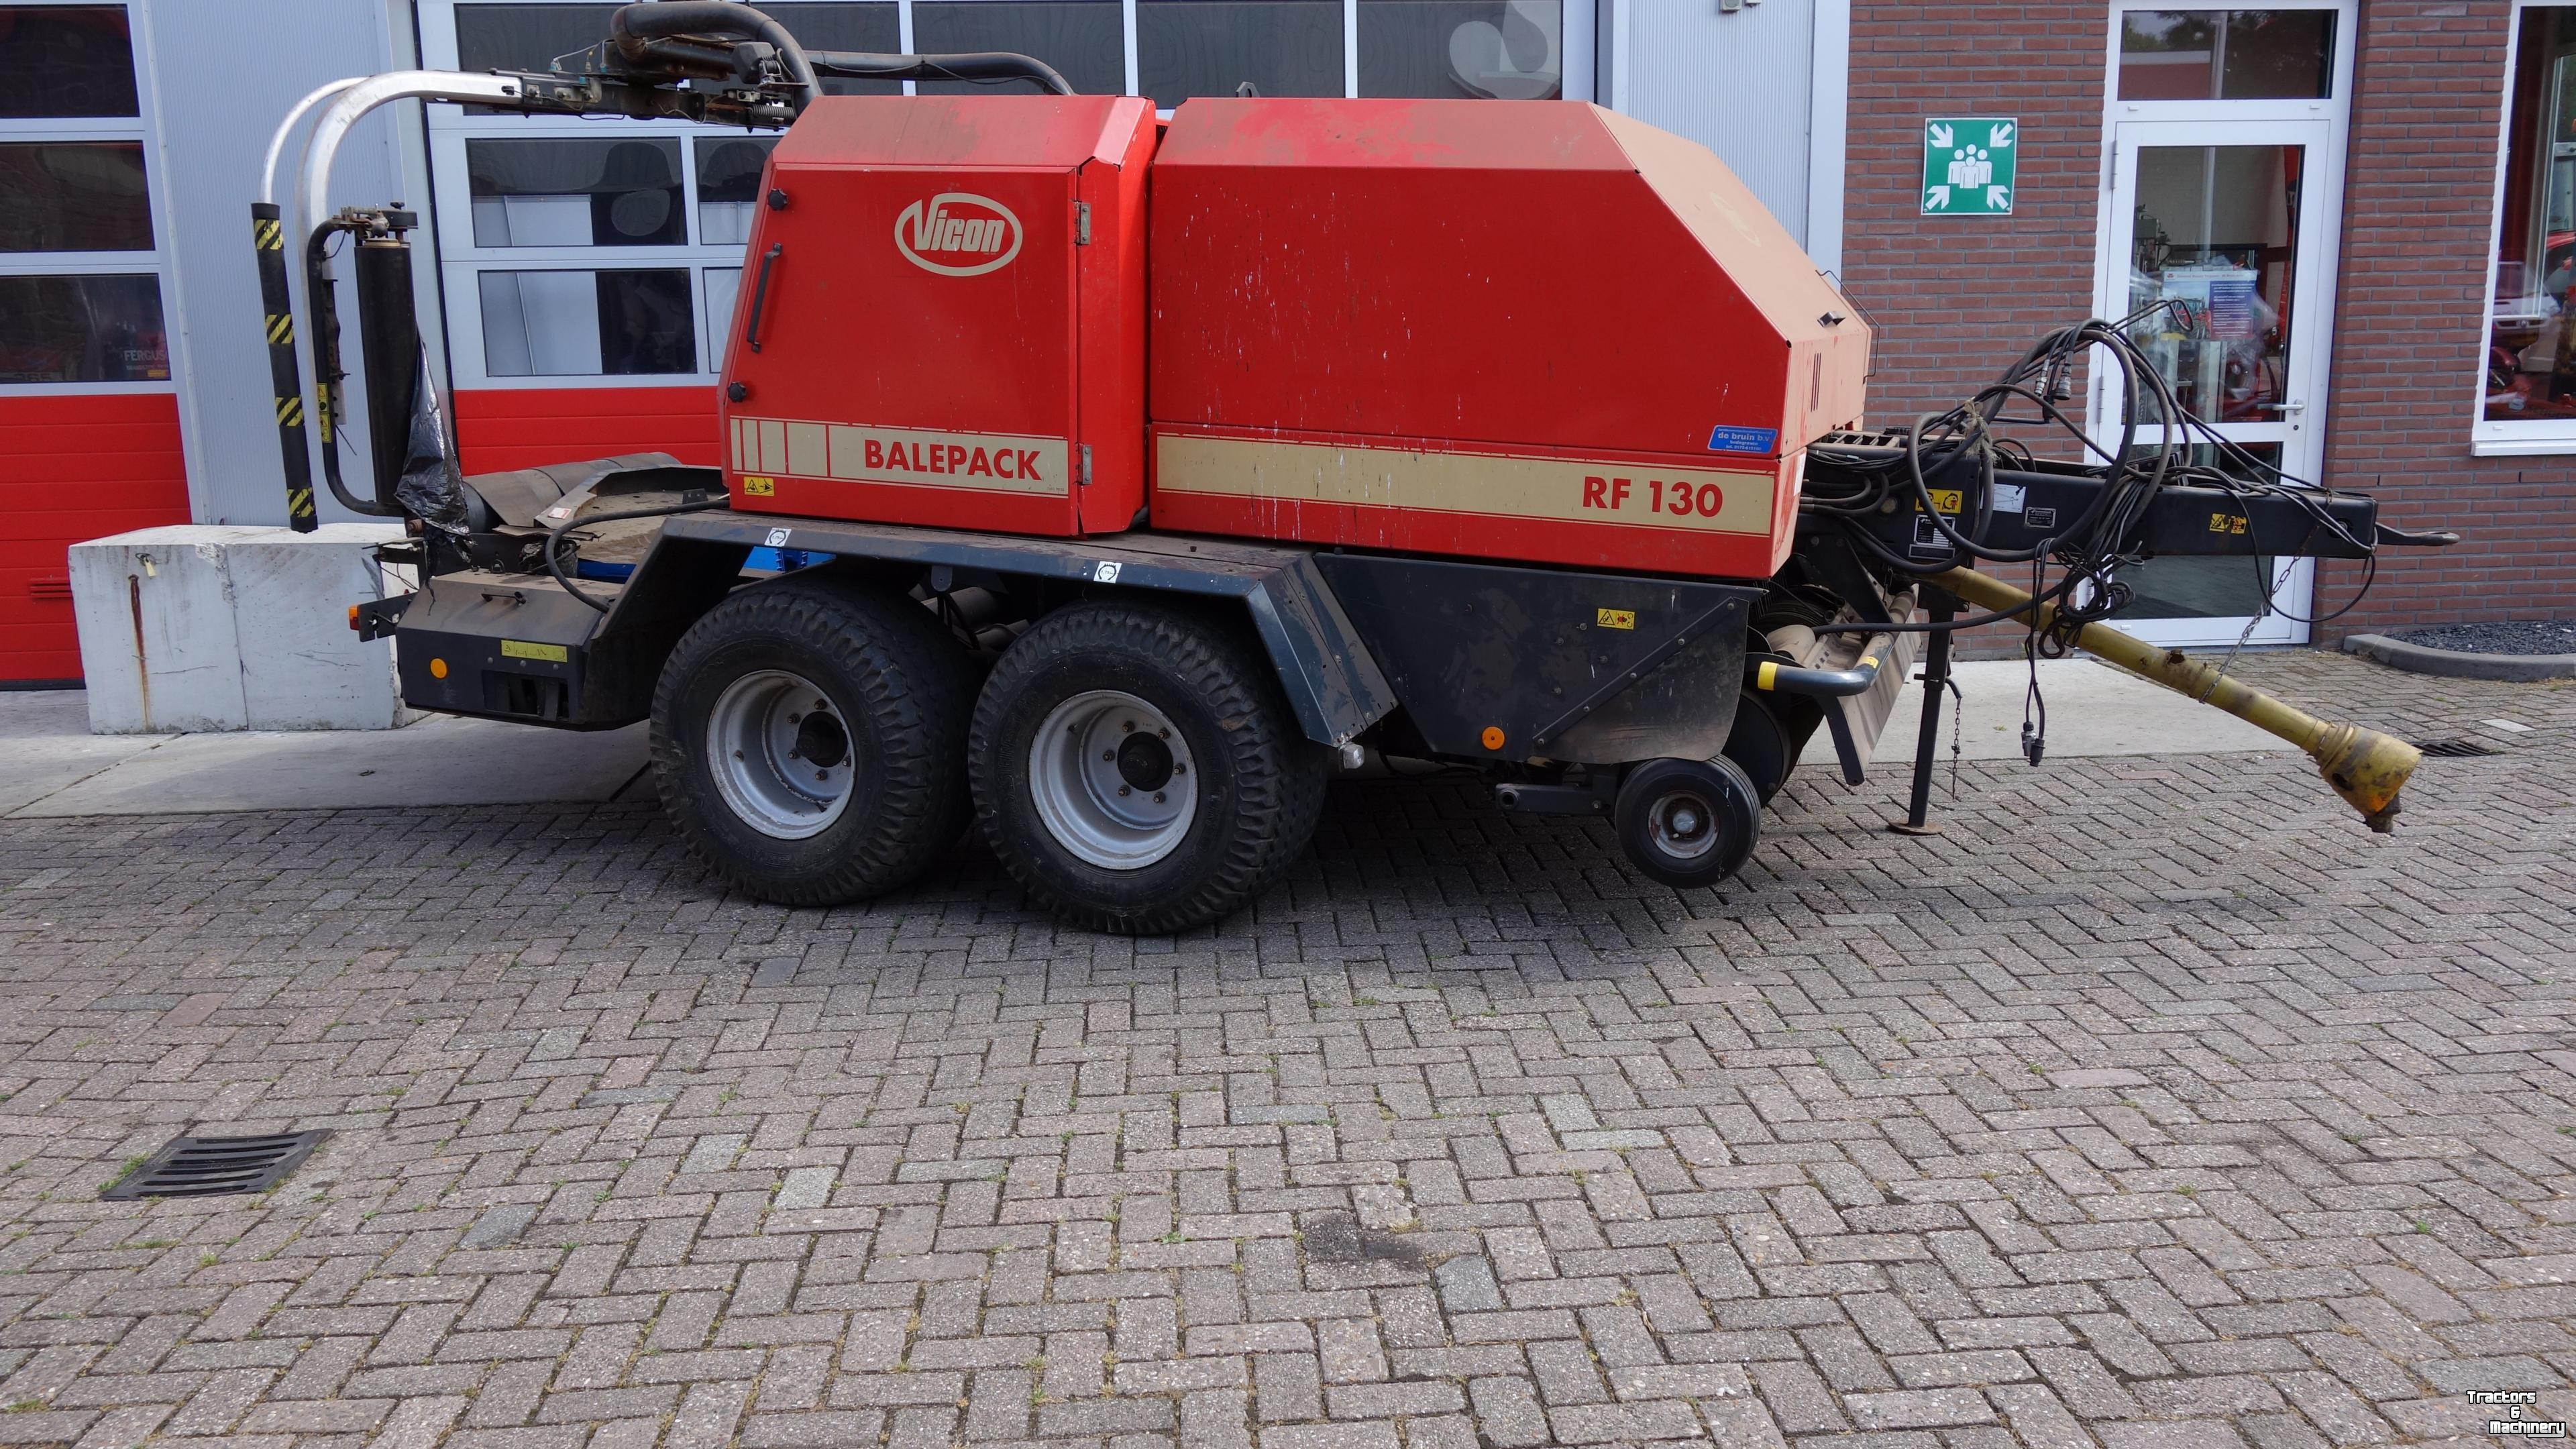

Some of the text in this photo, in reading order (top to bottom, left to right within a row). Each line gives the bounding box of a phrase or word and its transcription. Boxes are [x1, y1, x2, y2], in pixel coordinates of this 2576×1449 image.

[914, 193, 1005, 252] Vicon
[1731, 433, 1755, 441] bruin
[865, 439, 1042, 481] BALEPACK
[1582, 476, 1723, 517] RF 130
